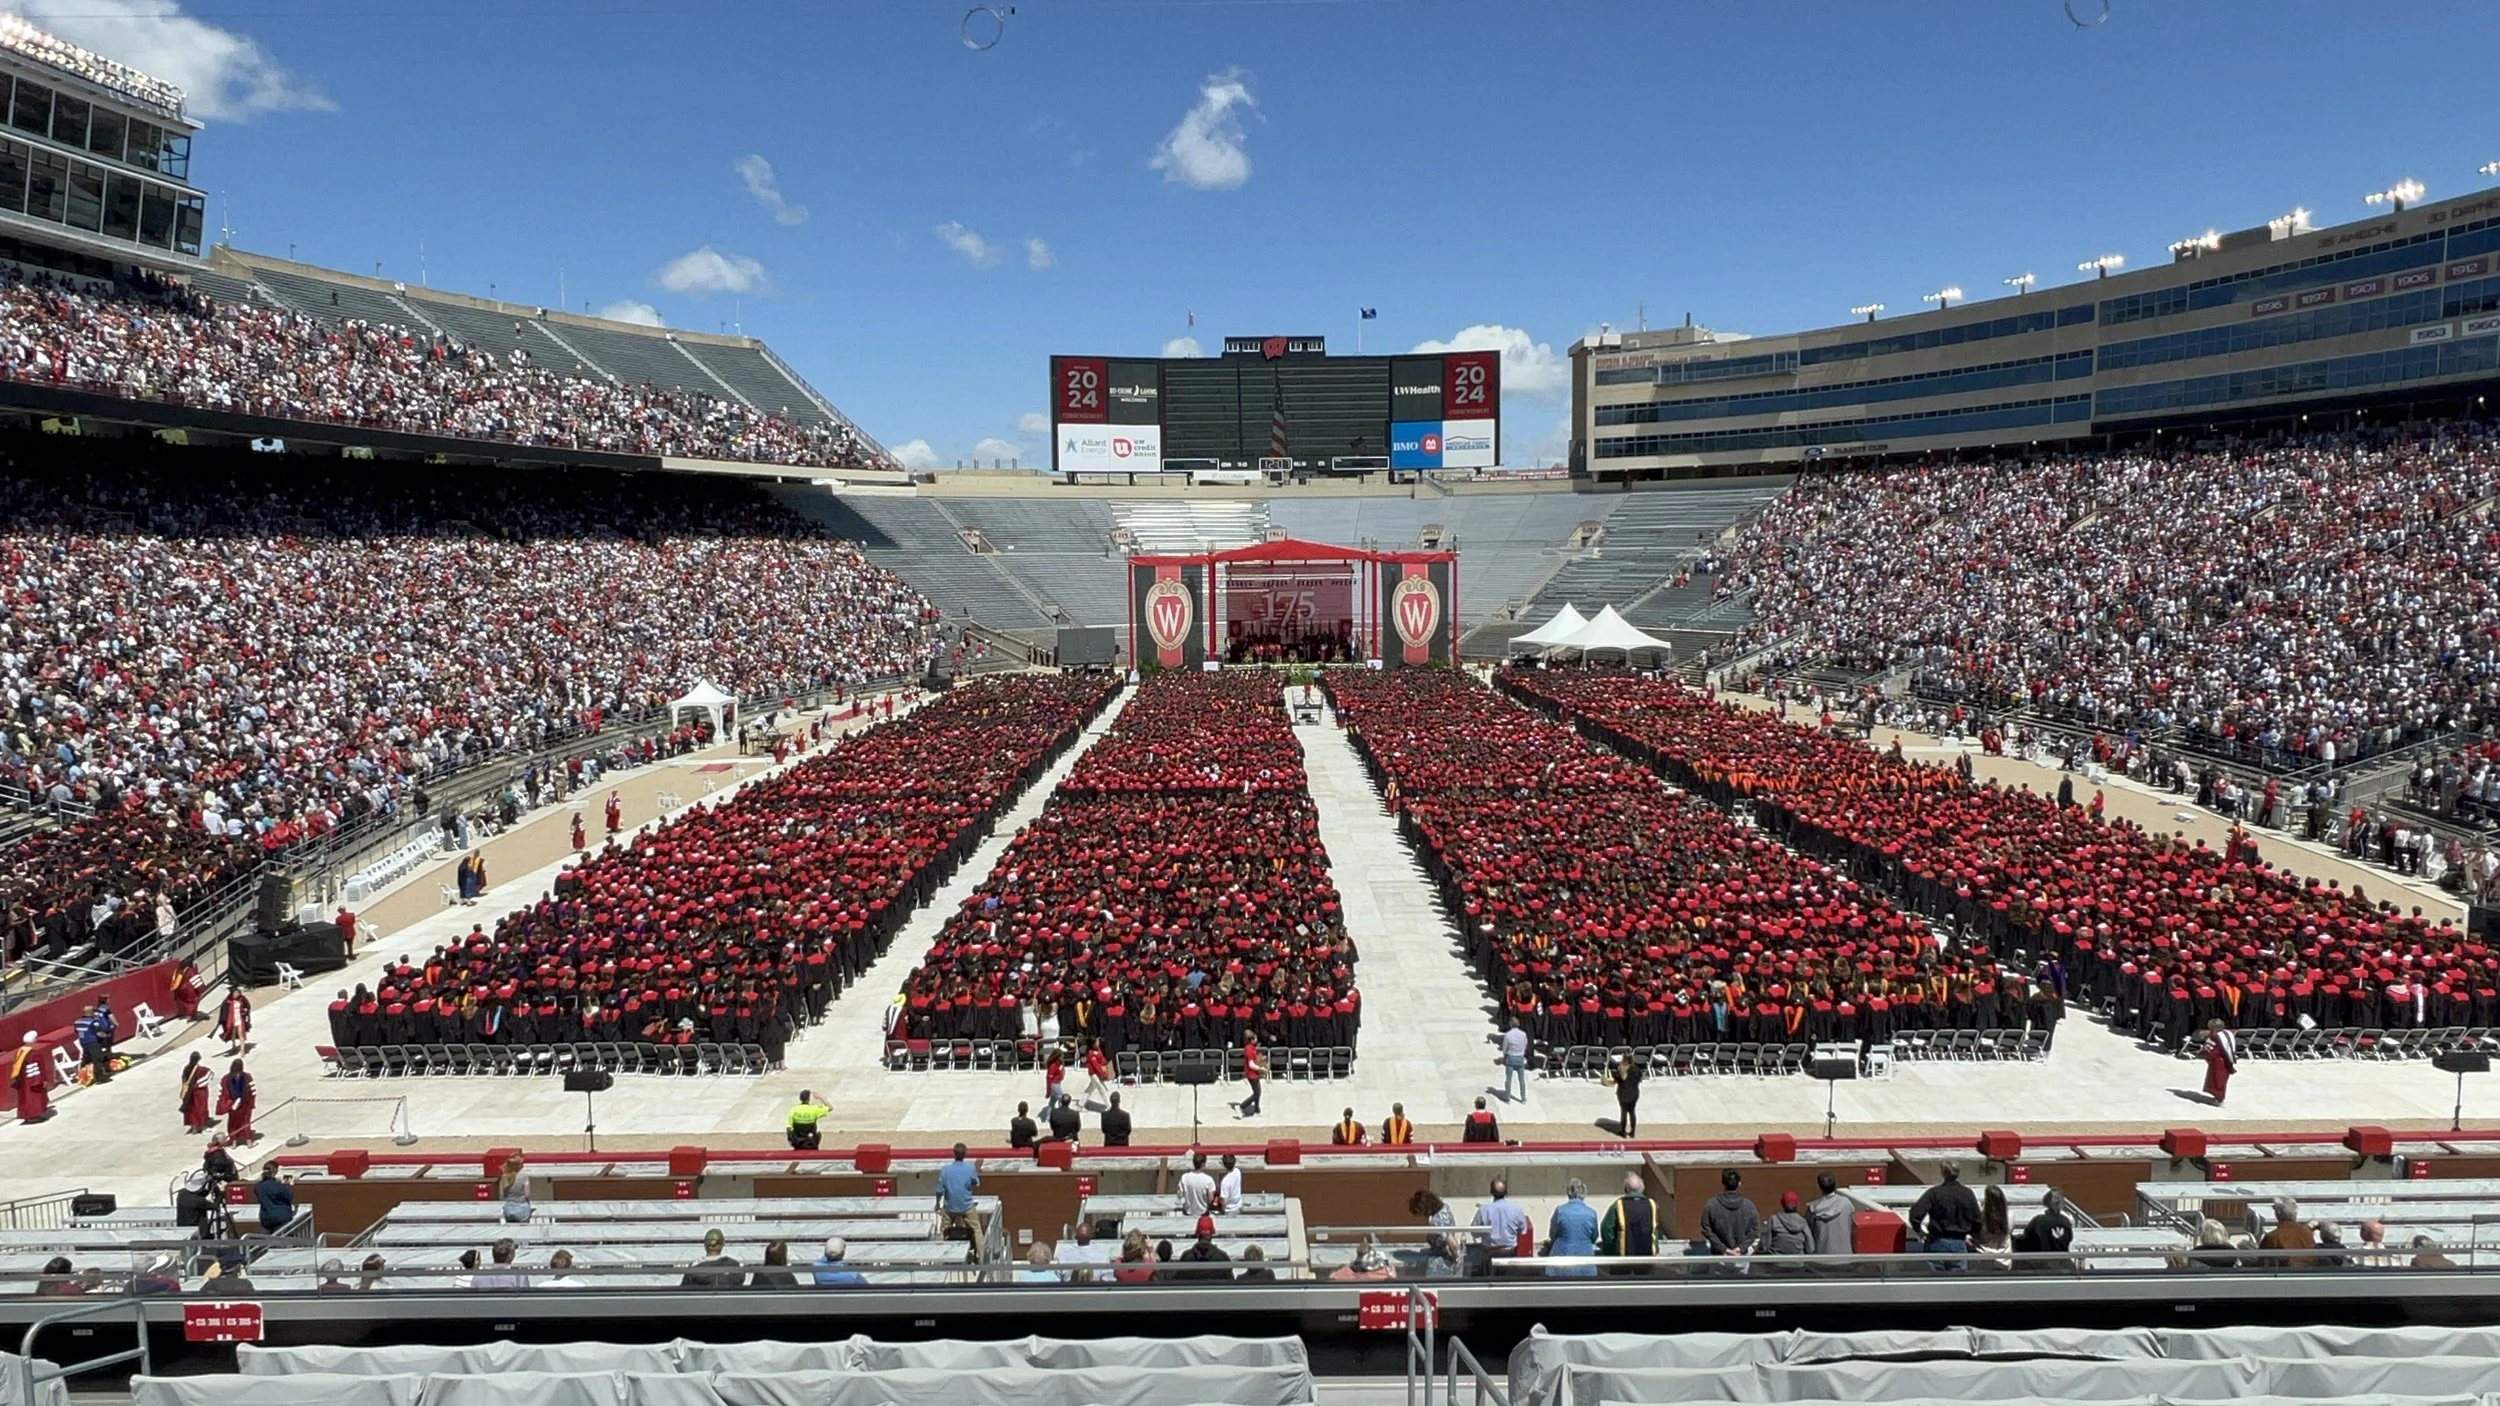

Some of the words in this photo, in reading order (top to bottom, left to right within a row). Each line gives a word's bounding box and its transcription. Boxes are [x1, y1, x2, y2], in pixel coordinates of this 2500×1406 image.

[2452, 263, 2478, 276] 1912
[2398, 272, 2429, 287] 1906
[2350, 283, 2376, 295] 1901
[1068, 370, 1098, 389] 20
[1455, 366, 1485, 384] 20
[1068, 390, 1098, 408] 24
[1455, 385, 1485, 404] 24
[1081, 439, 1107, 447] Alliant
[1393, 441, 1418, 451] BMO
[1262, 591, 1316, 627] 175
[1403, 599, 1429, 634] W
[1156, 602, 1182, 637] W
